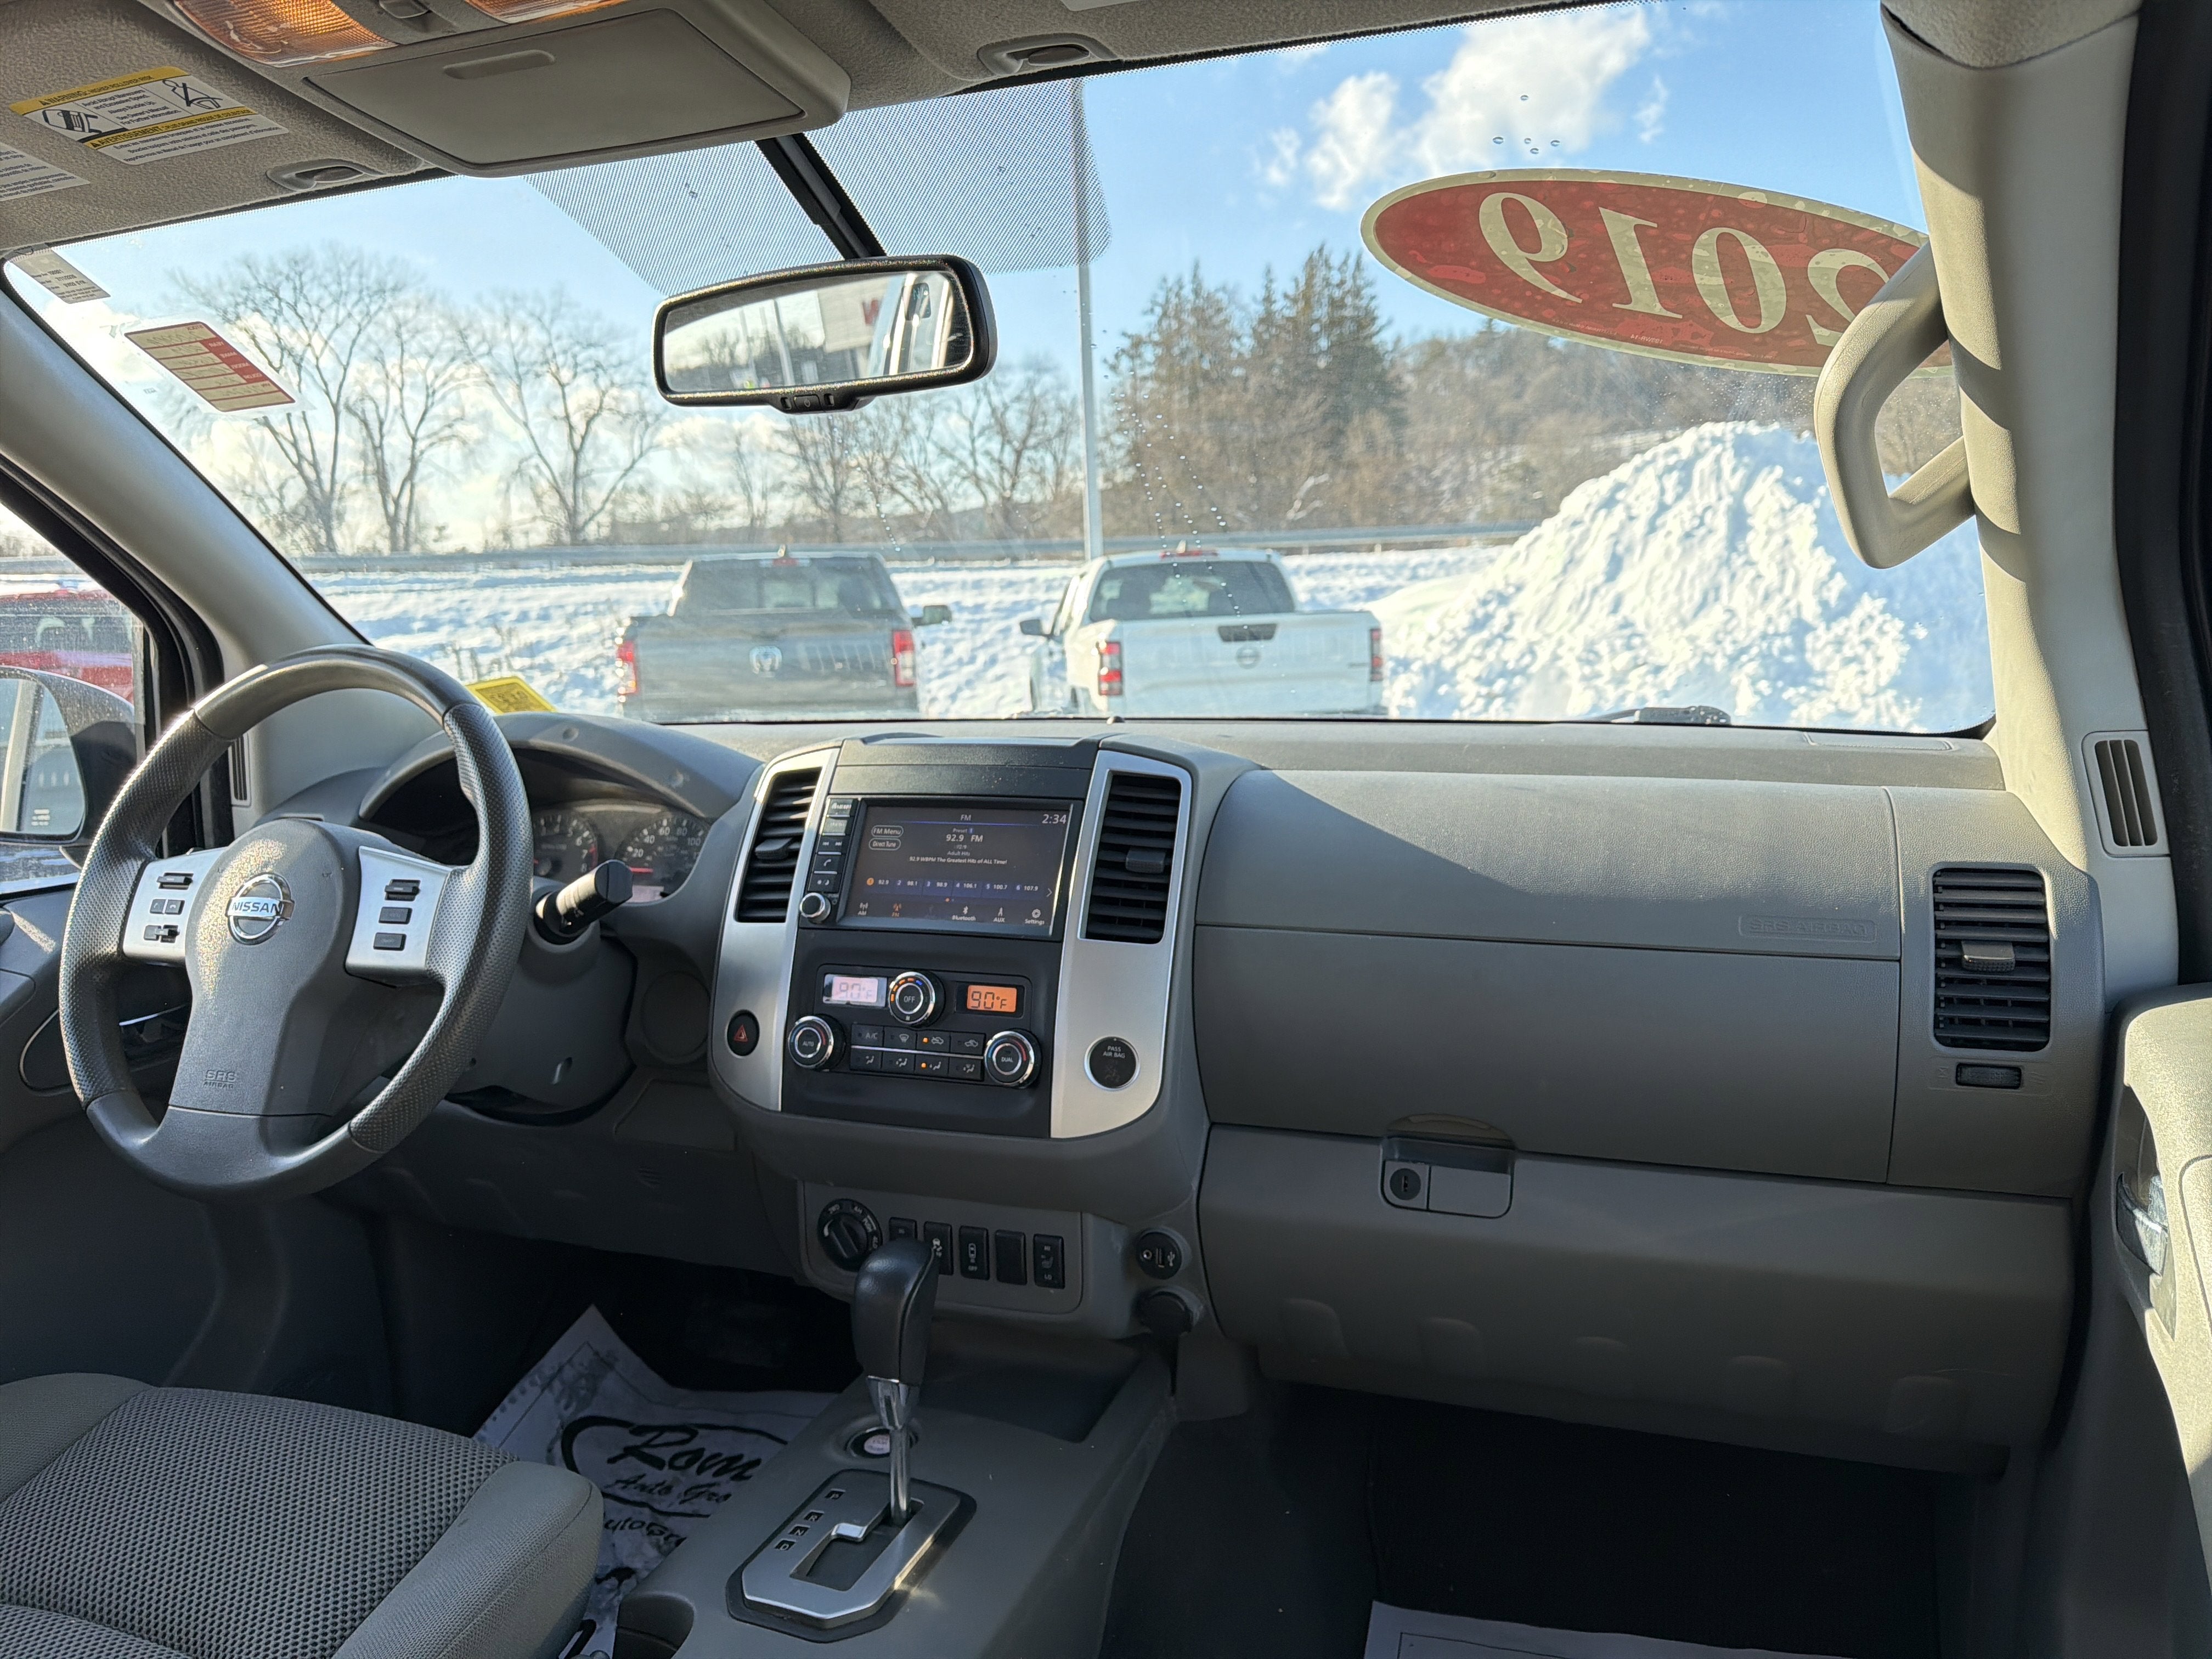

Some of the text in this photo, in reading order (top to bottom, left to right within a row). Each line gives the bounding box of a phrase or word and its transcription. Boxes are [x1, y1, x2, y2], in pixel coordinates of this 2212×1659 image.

[1042, 814, 1066, 824] 2:34
[658, 826, 670, 836] 60
[575, 836, 583, 846] 6
[644, 835, 655, 844] 40
[687, 837, 701, 847] 100
[582, 849, 588, 859] 7
[632, 848, 644, 857] 20
[232, 901, 284, 914] NISSAN
